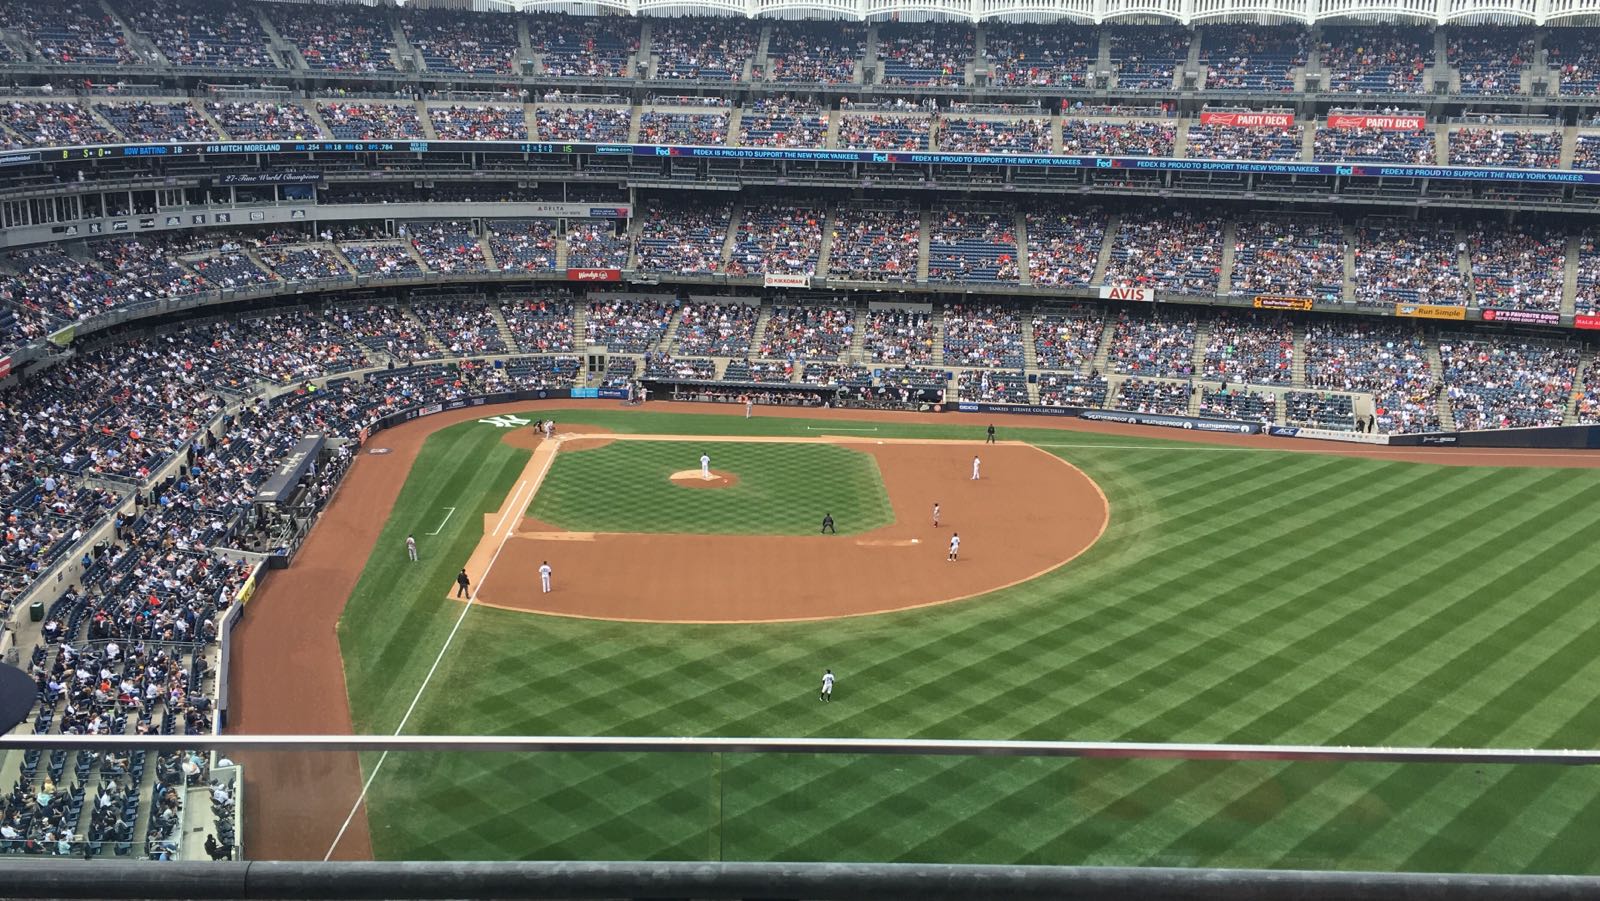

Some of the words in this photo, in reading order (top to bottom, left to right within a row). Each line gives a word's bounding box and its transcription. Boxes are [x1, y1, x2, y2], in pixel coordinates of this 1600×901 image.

[1238, 114, 1264, 124] PARTY
[1265, 116, 1288, 125] DECK
[1366, 118, 1394, 127] PARTY
[1395, 118, 1419, 128] DECK
[244, 144, 280, 152] MORELAND
[656, 147, 681, 156] FedEx
[754, 150, 782, 158] SUPPORT
[873, 154, 897, 162] FedEx
[1097, 159, 1122, 167] FedEx
[1336, 166, 1365, 175] FedEx
[283, 174, 319, 182] Champions
[1526, 172, 1547, 180] YORK
[1109, 288, 1144, 300] AVIS
[1088, 414, 1127, 422] WEATHERPROOF
[1142, 419, 1183, 427] WEATHERPROOF
